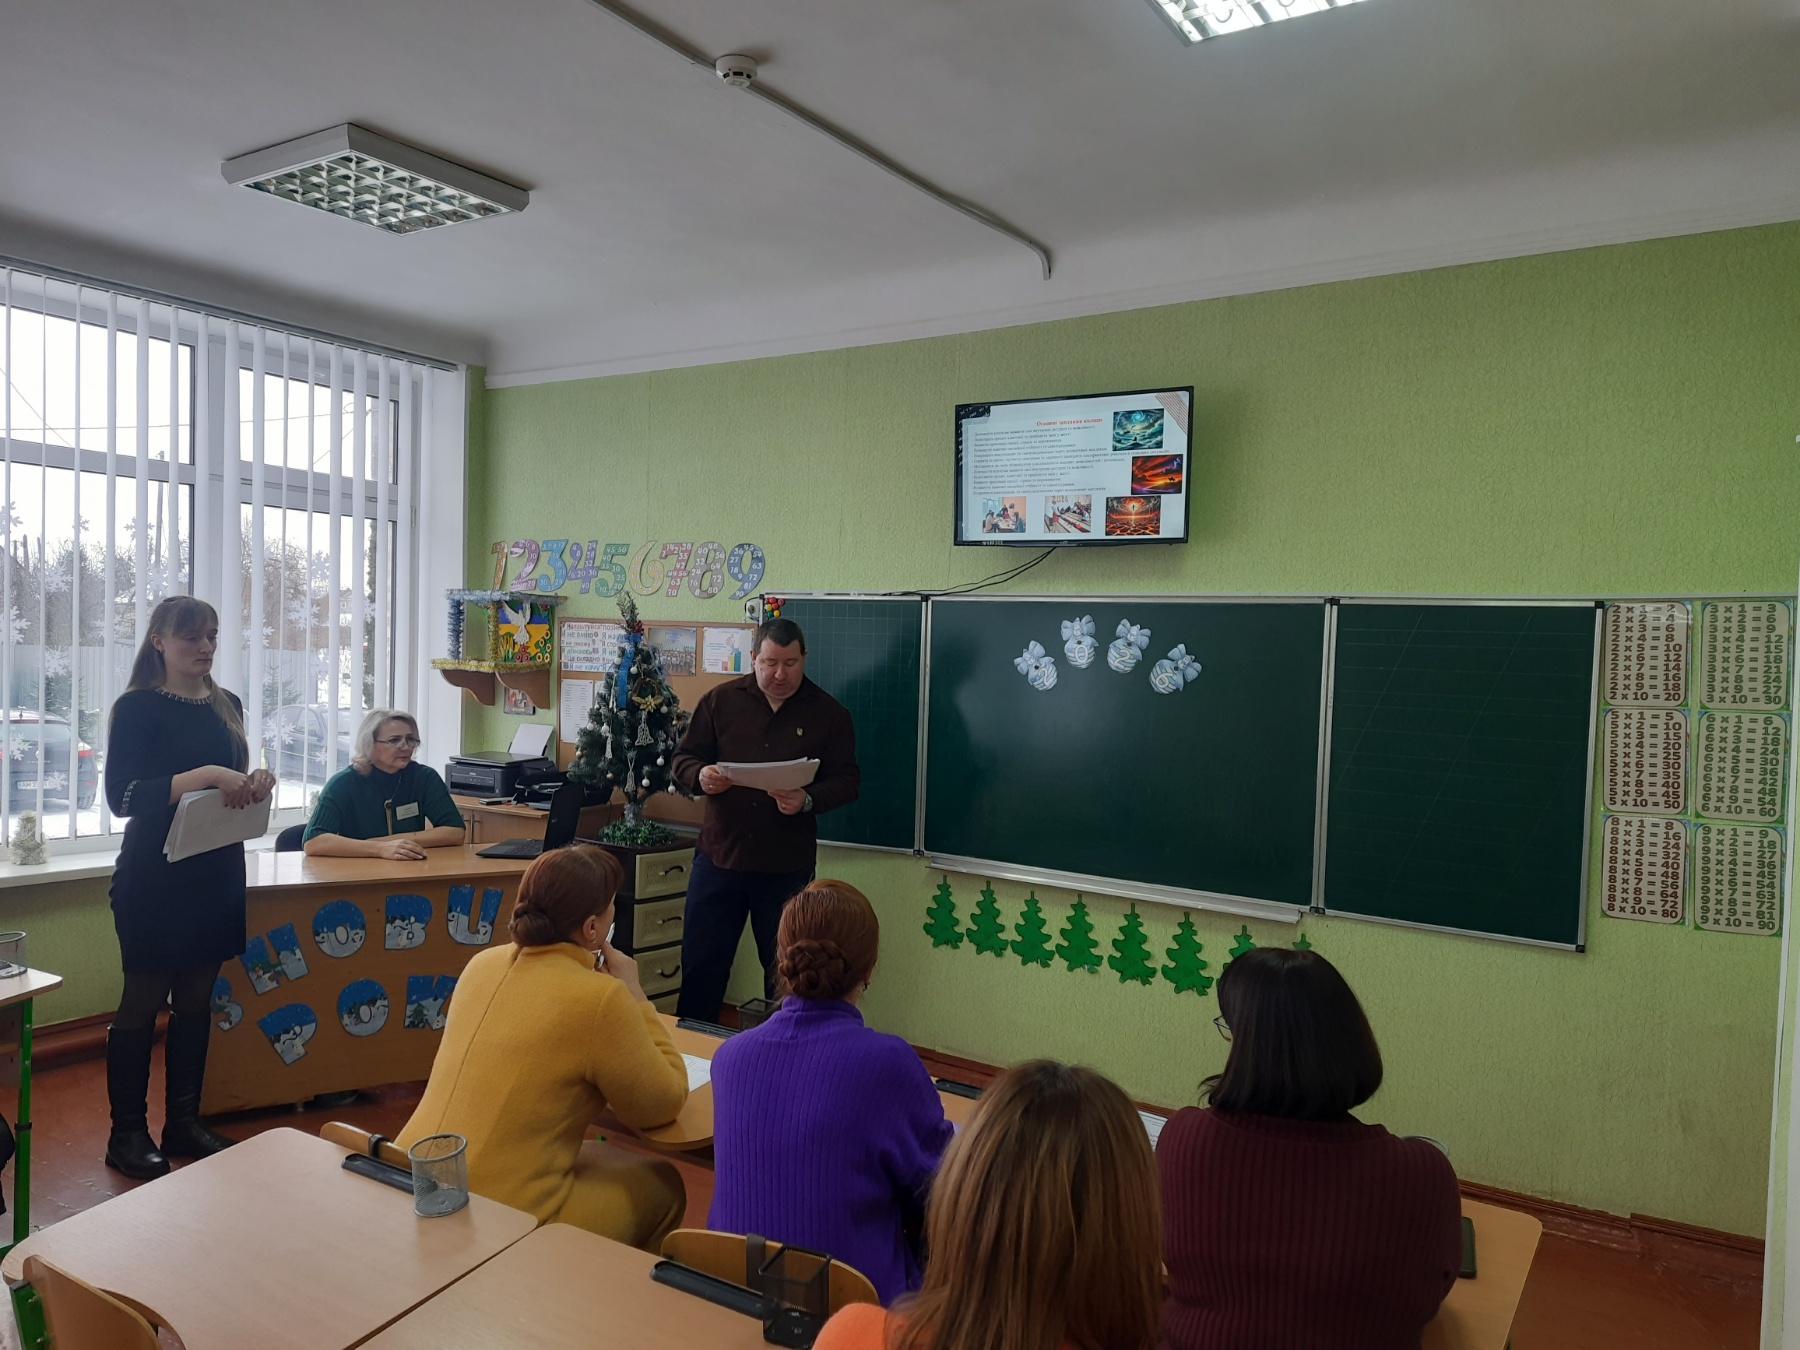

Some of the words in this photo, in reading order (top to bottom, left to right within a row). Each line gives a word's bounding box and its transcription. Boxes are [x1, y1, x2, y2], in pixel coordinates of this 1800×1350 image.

[1710, 604, 1718, 613] 3
[1738, 604, 1747, 613] 1
[1767, 604, 1776, 613] 3
[1612, 624, 1620, 632] 2
[1638, 624, 1647, 632] 3
[1666, 624, 1675, 632] 6
[602, 632, 606, 640] Я
[1709, 634, 1717, 643] 3
[1735, 635, 1745, 643] 4
[1765, 634, 1783, 643] 12
[602, 648, 606, 656] Я
[1611, 644, 1619, 652] 2
[1637, 644, 1645, 652] 5
[1664, 644, 1682, 652] 10
[1611, 662, 1618, 671] 2
[1636, 663, 1644, 671] 7
[1664, 663, 1681, 672] 14
[1708, 664, 1716, 673] 3
[1735, 665, 1744, 673] 7
[1763, 665, 1782, 674] 21
[1707, 714, 1716, 722] 6
[1735, 715, 1743, 724] 1
[1764, 717, 1773, 725] 6
[1611, 721, 1619, 729] 5
[1636, 721, 1644, 730] 2
[1664, 722, 1682, 731] 10
[1610, 730, 1618, 738] 5
[1636, 731, 1644, 739] 3
[1664, 732, 1681, 740] 15
[1706, 734, 1714, 742] 6
[1732, 735, 1741, 744] 3
[1761, 737, 1780, 746] 18
[1609, 788, 1617, 796] 5
[1635, 789, 1644, 797] 9
[1662, 791, 1680, 799] 45
[1611, 827, 1619, 835] 8
[1636, 829, 1644, 838] 2
[1664, 832, 1681, 841] 16
[1702, 846, 1711, 855] 9
[1729, 848, 1738, 857] 3
[1757, 850, 1776, 859] 27
[1609, 865, 1617, 874] 8
[1634, 868, 1643, 876] 6
[1661, 871, 1679, 880] 48
[1701, 876, 1710, 884] 9
[1728, 878, 1737, 887] 6
[1756, 880, 1776, 890] 54
